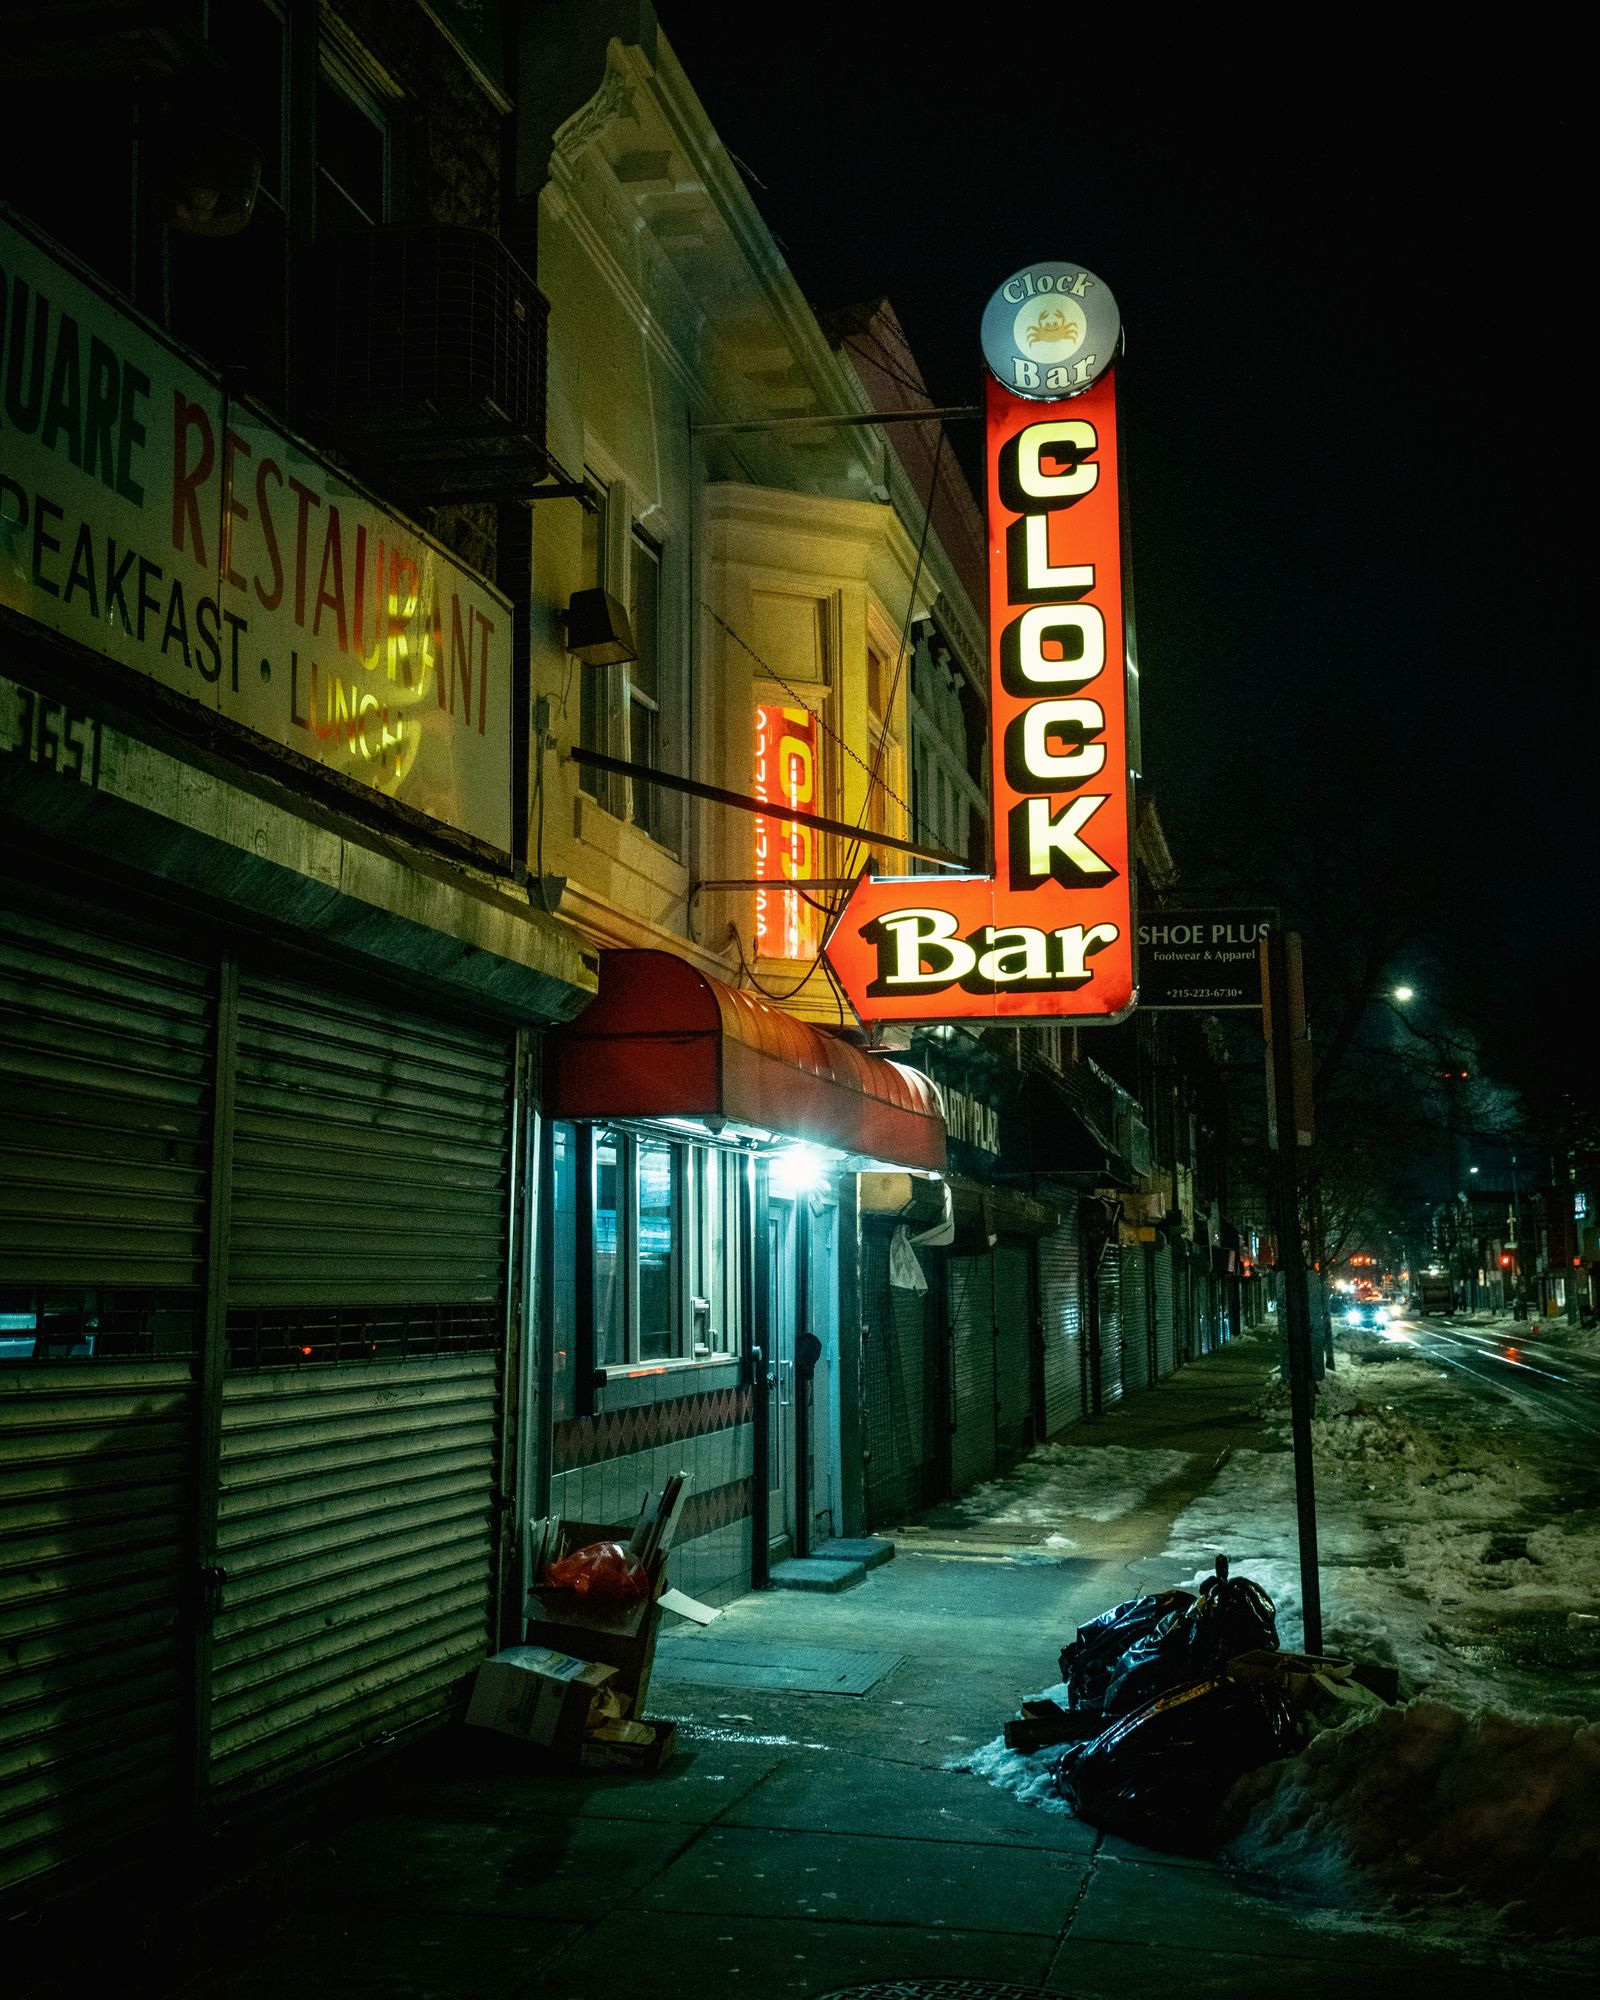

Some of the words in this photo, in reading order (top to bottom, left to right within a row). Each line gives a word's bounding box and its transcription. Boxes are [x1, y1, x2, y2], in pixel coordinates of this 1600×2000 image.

[1002, 272, 1094, 304] Clock
[1012, 355, 1096, 389] Bar
[0, 264, 150, 508] UARE
[172, 389, 494, 737] RESTAURANT
[1013, 419, 1113, 880] CLOCK
[291, 651, 402, 777] LUNCH
[872, 907, 1120, 988] Bar
[1139, 925, 1204, 945] SHOE
[1212, 923, 1270, 944] PLUS
[1153, 951, 1201, 961] Footwear
[1204, 951, 1213, 960] &
[1215, 950, 1256, 963] Apparel
